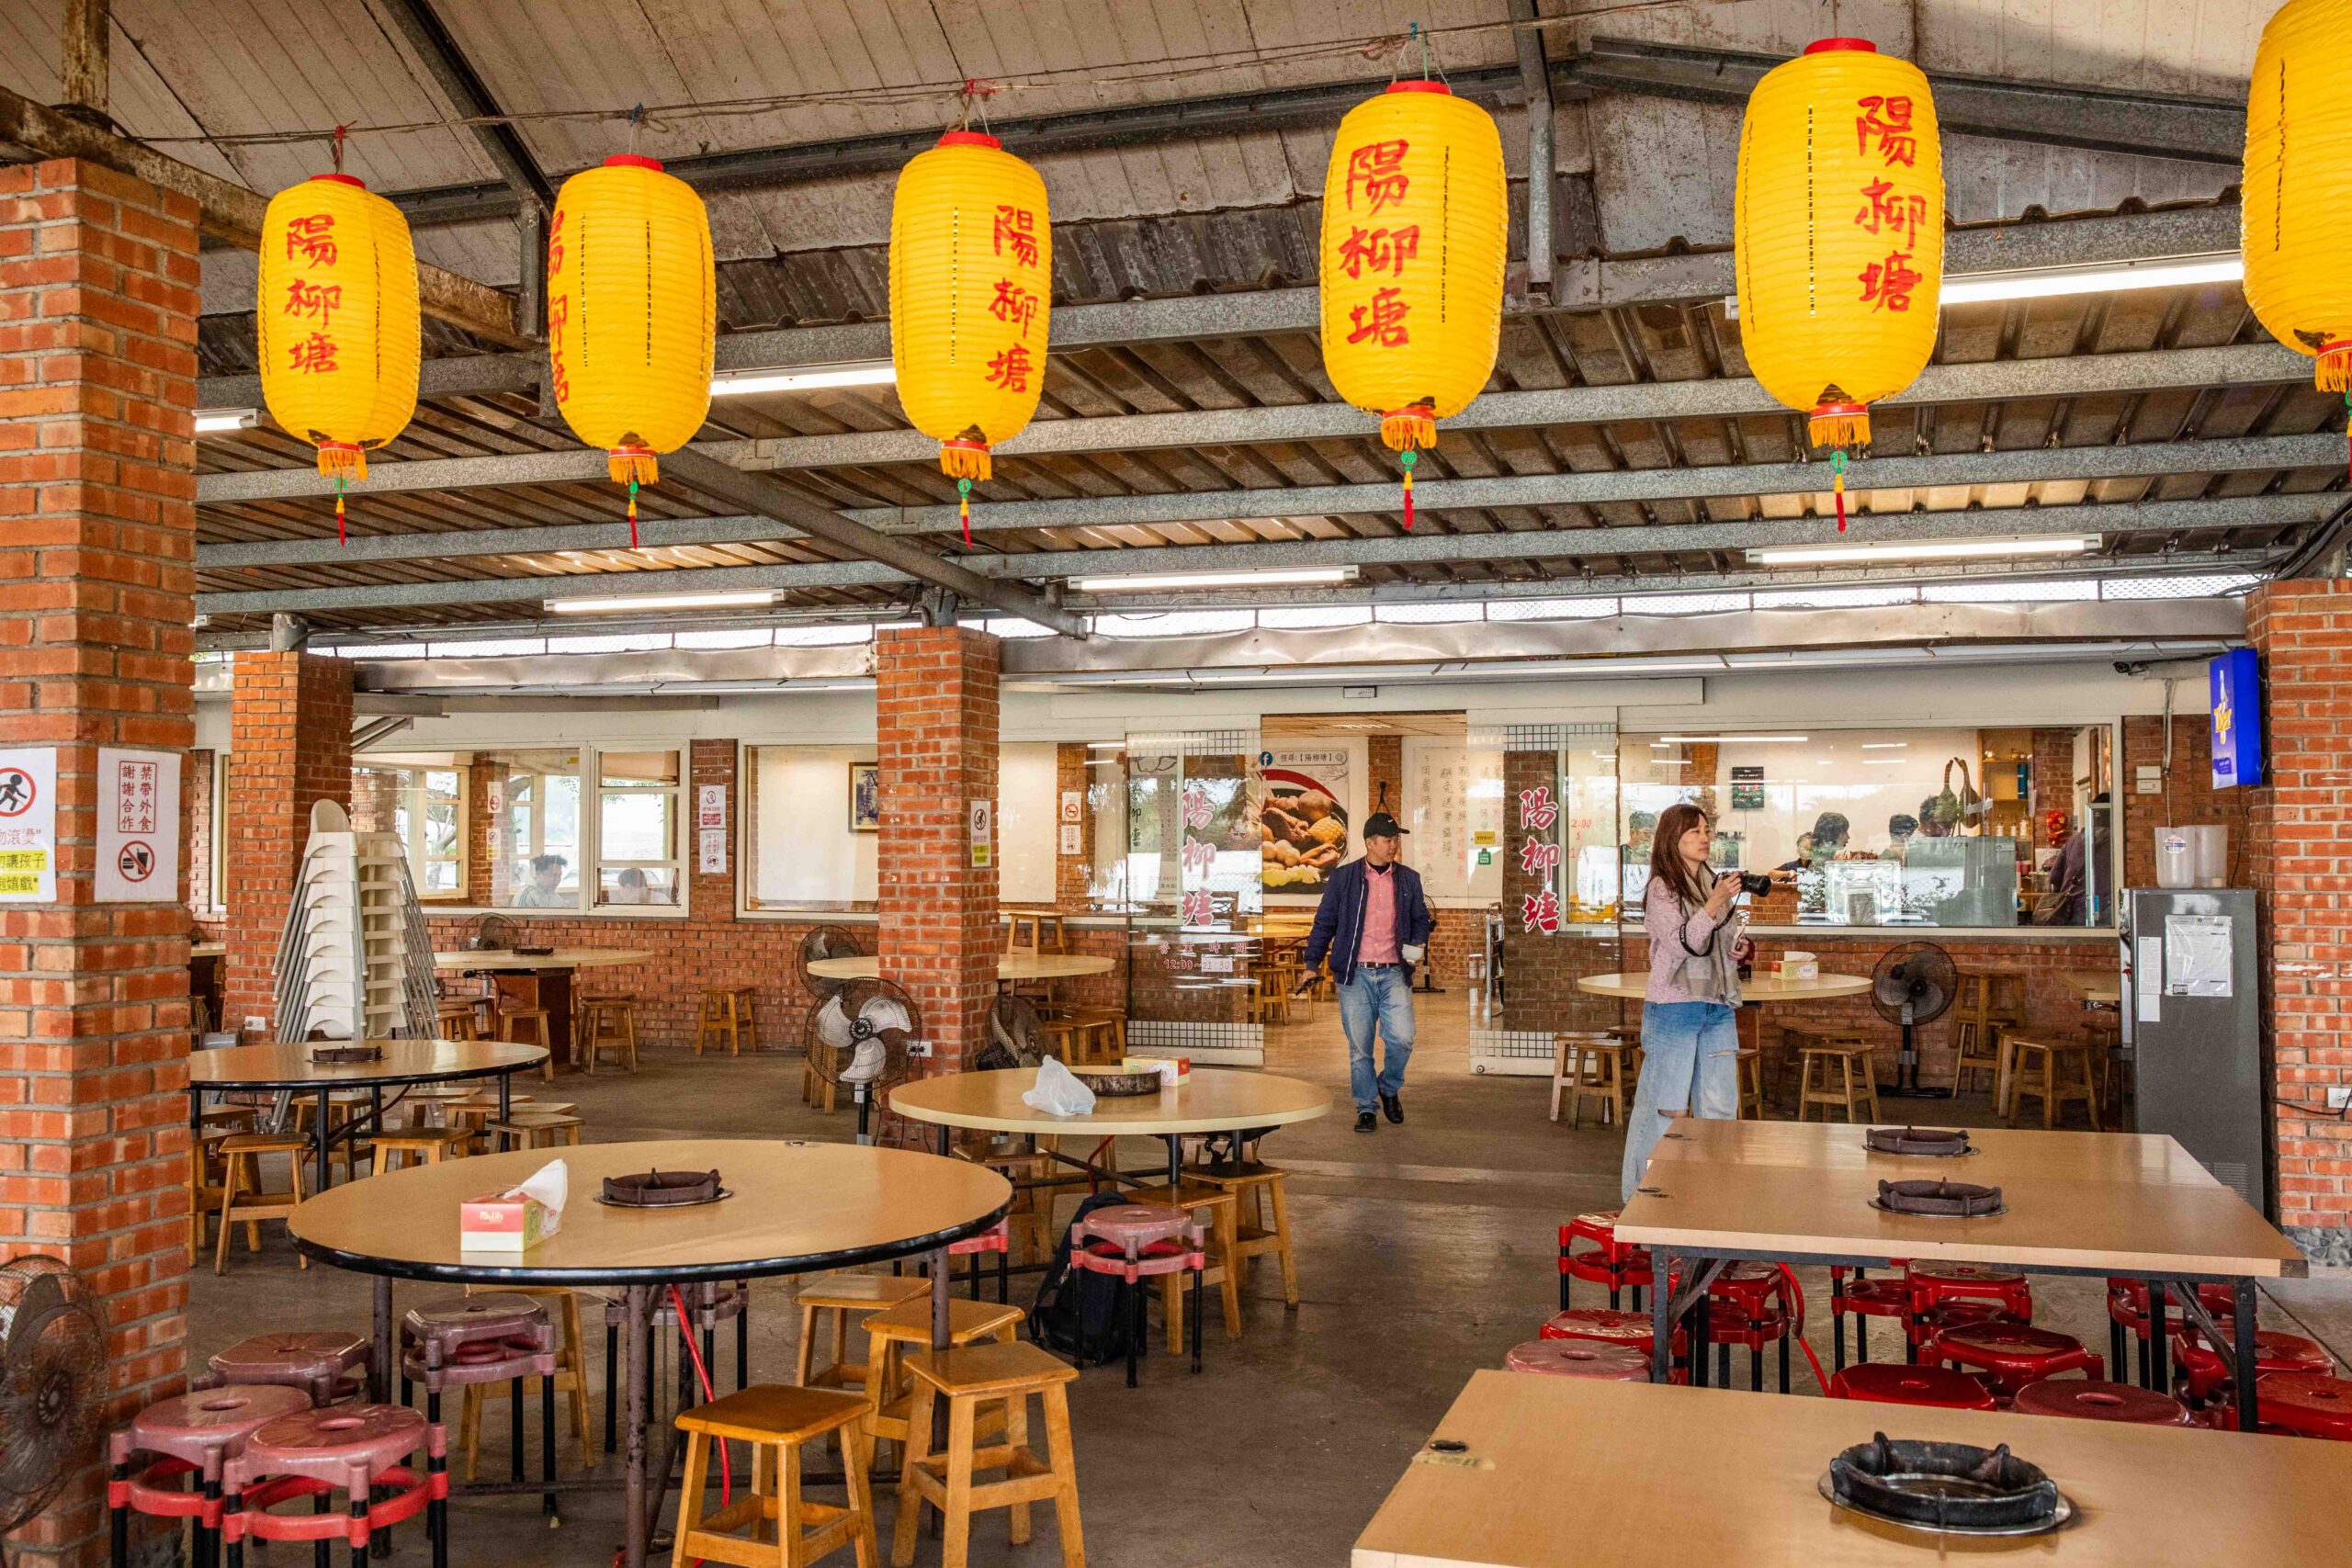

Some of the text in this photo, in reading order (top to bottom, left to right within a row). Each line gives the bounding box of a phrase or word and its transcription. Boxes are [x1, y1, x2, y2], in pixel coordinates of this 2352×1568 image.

[1339, 139, 1419, 347] 陽柳塘
[1856, 95, 1927, 312] 陽柳塘
[285, 214, 342, 373] 陽柳塘
[985, 205, 1051, 393] 陽柳塘
[121, 764, 135, 830] 謝謝合作
[140, 764, 153, 831] 禁帶外食
[1181, 788, 1216, 926] 陽柳塘
[1519, 786, 1560, 933] 陽柳塘
[1159, 941, 1247, 955] 營業時間
